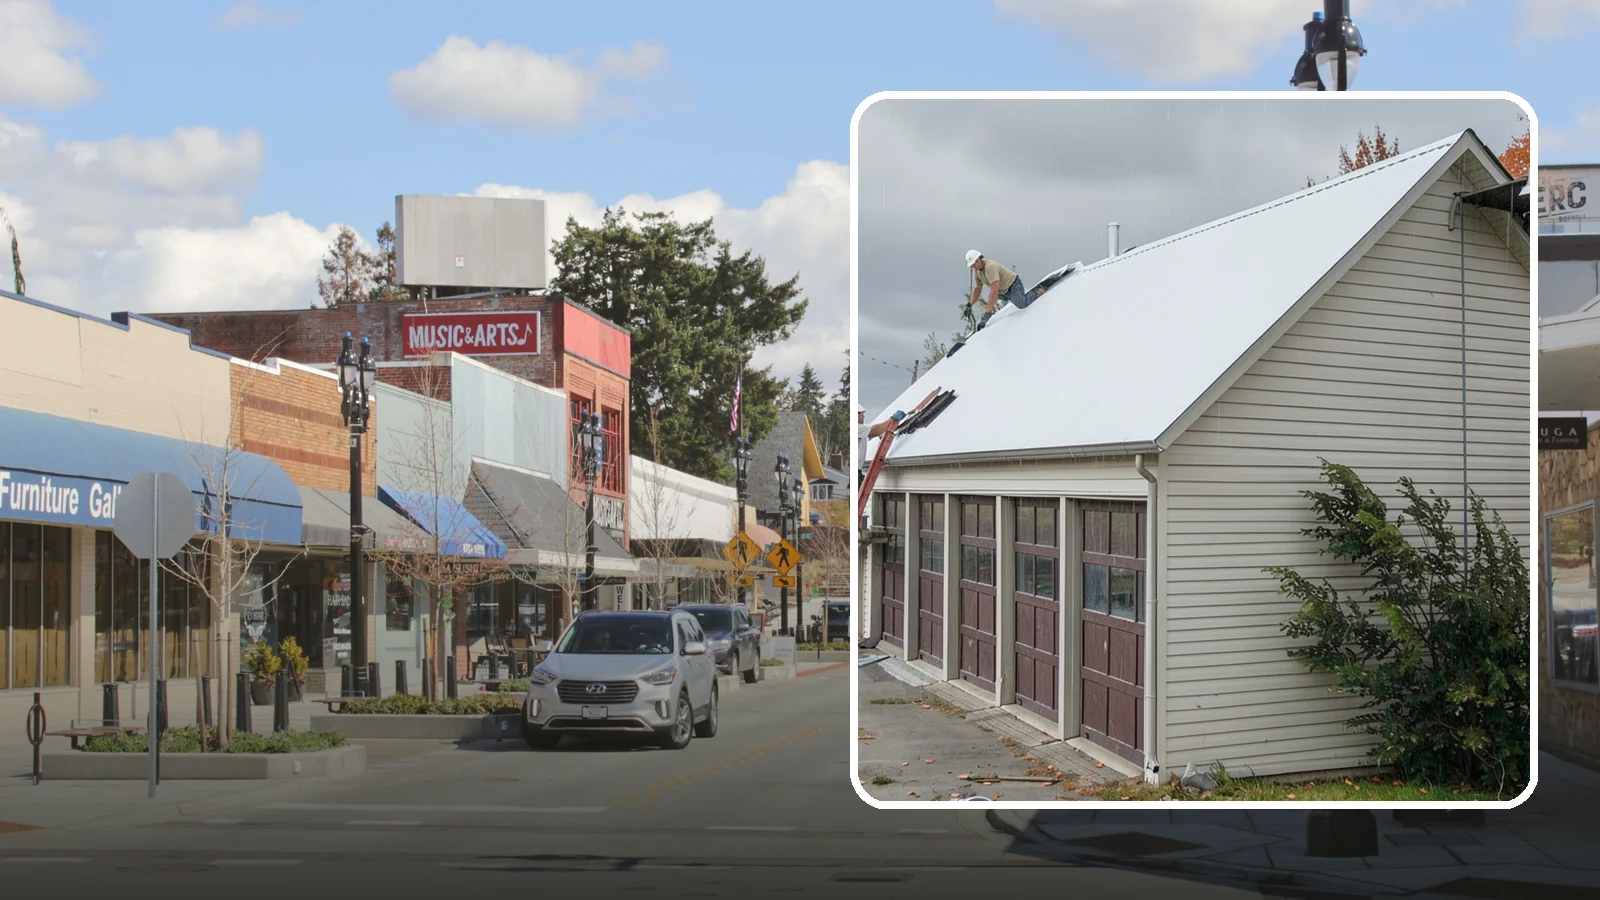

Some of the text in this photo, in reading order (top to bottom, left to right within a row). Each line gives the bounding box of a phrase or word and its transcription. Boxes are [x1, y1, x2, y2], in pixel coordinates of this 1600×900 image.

[409, 323, 520, 349] MUSIC&ARTS
[0, 471, 121, 519] Furniture Gal
